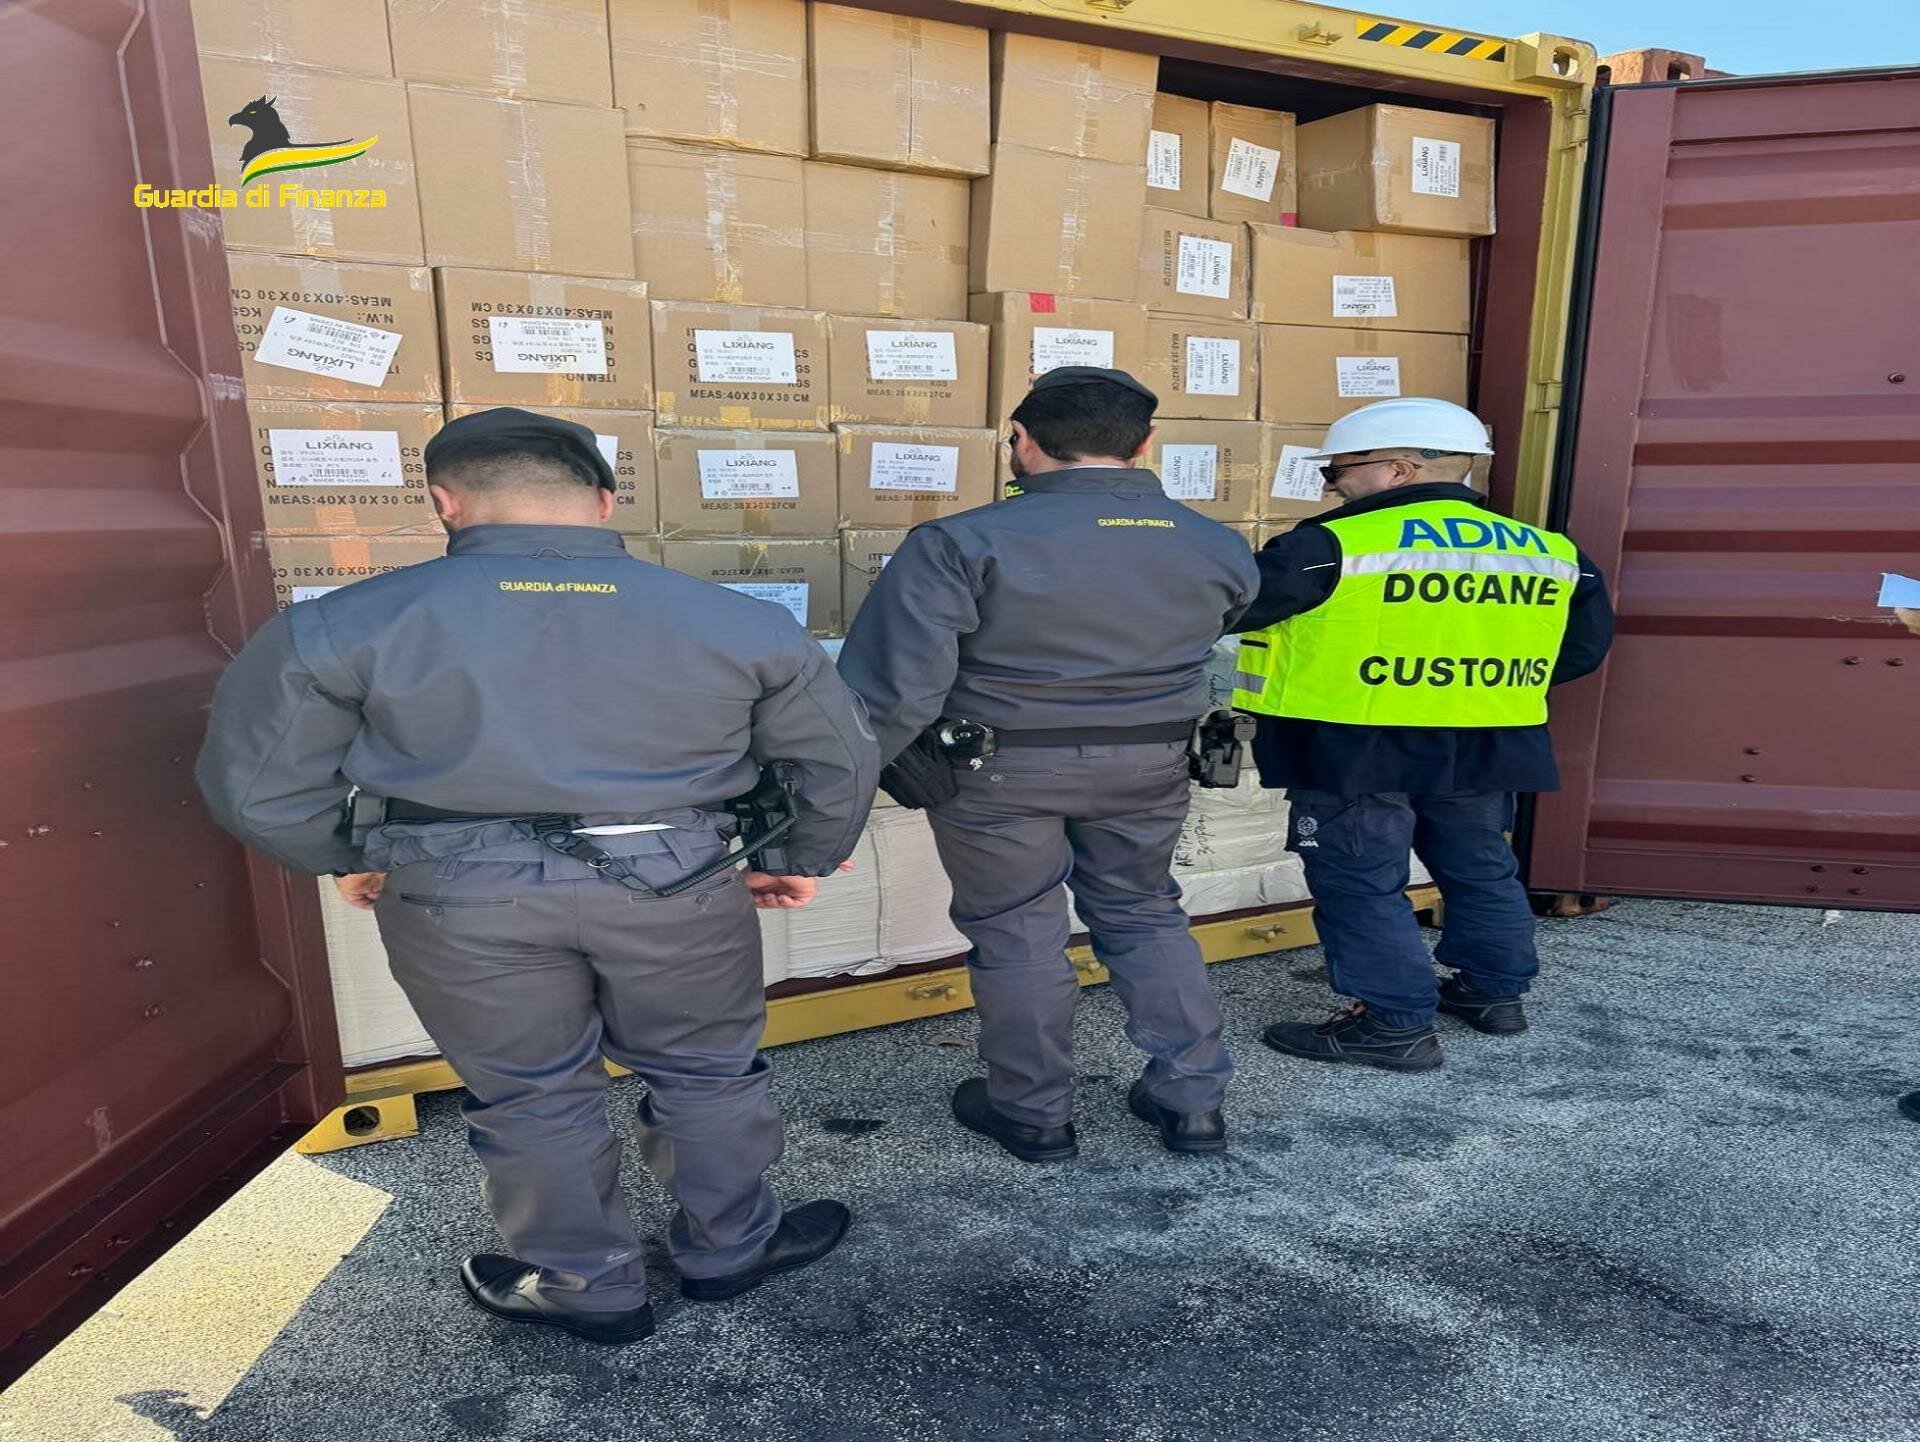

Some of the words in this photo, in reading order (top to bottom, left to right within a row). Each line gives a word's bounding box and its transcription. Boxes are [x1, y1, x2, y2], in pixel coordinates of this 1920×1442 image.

[722, 341, 775, 350] LIXIANG
[891, 341, 938, 349] LIXIANG
[1055, 337, 1098, 346] LIXIANG
[286, 347, 356, 370] LIXIANG
[517, 353, 577, 363] LIXIANG
[305, 441, 374, 450] LIXIANG
[895, 453, 941, 462] LIXIANG
[725, 459, 777, 467] LIXIANG
[404, 495, 425, 504] CM
[1398, 517, 1549, 554] ADM
[500, 581, 554, 592] GUARDIA
[555, 582, 566, 592] di
[566, 582, 618, 593] FINANZA
[1383, 572, 1560, 606] DOGANE
[1359, 655, 1549, 687] CUSTOMS
